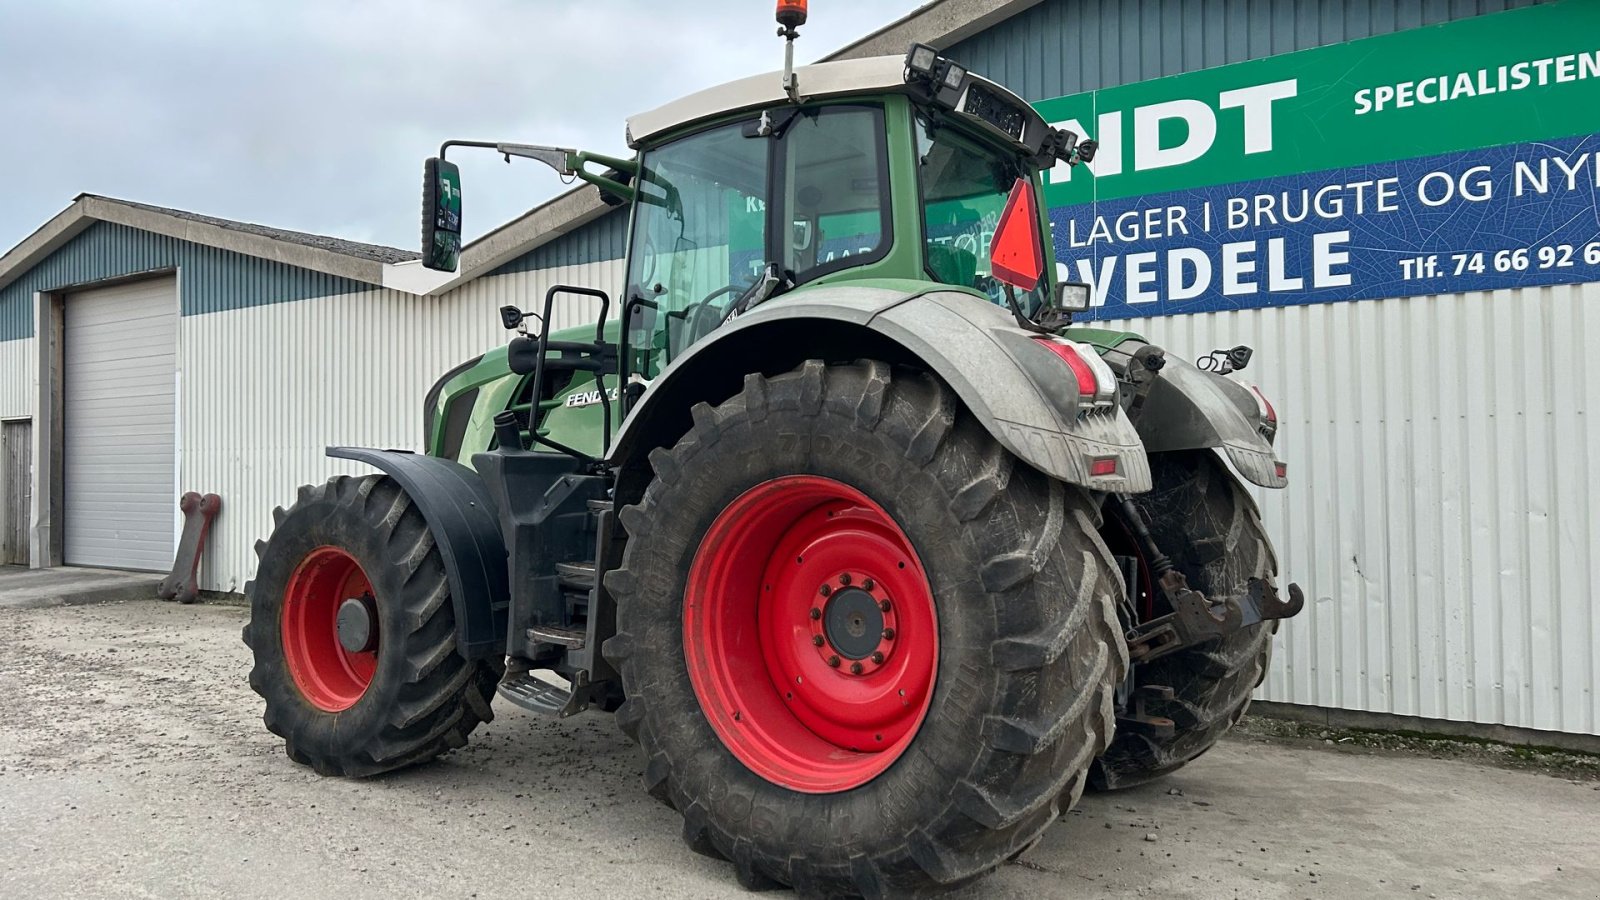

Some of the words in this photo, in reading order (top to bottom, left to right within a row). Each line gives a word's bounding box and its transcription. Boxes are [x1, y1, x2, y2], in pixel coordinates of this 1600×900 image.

[1069, 205, 1189, 248] LAGER
[1204, 201, 1210, 232] I
[1227, 177, 1399, 230] BRUGTE
[1417, 165, 1492, 207] OG
[1515, 151, 1600, 197] NY
[1398, 255, 1444, 280] Tlf.
[1451, 252, 1486, 276] 74
[1494, 248, 1529, 272] 66
[1538, 244, 1574, 269] 92
